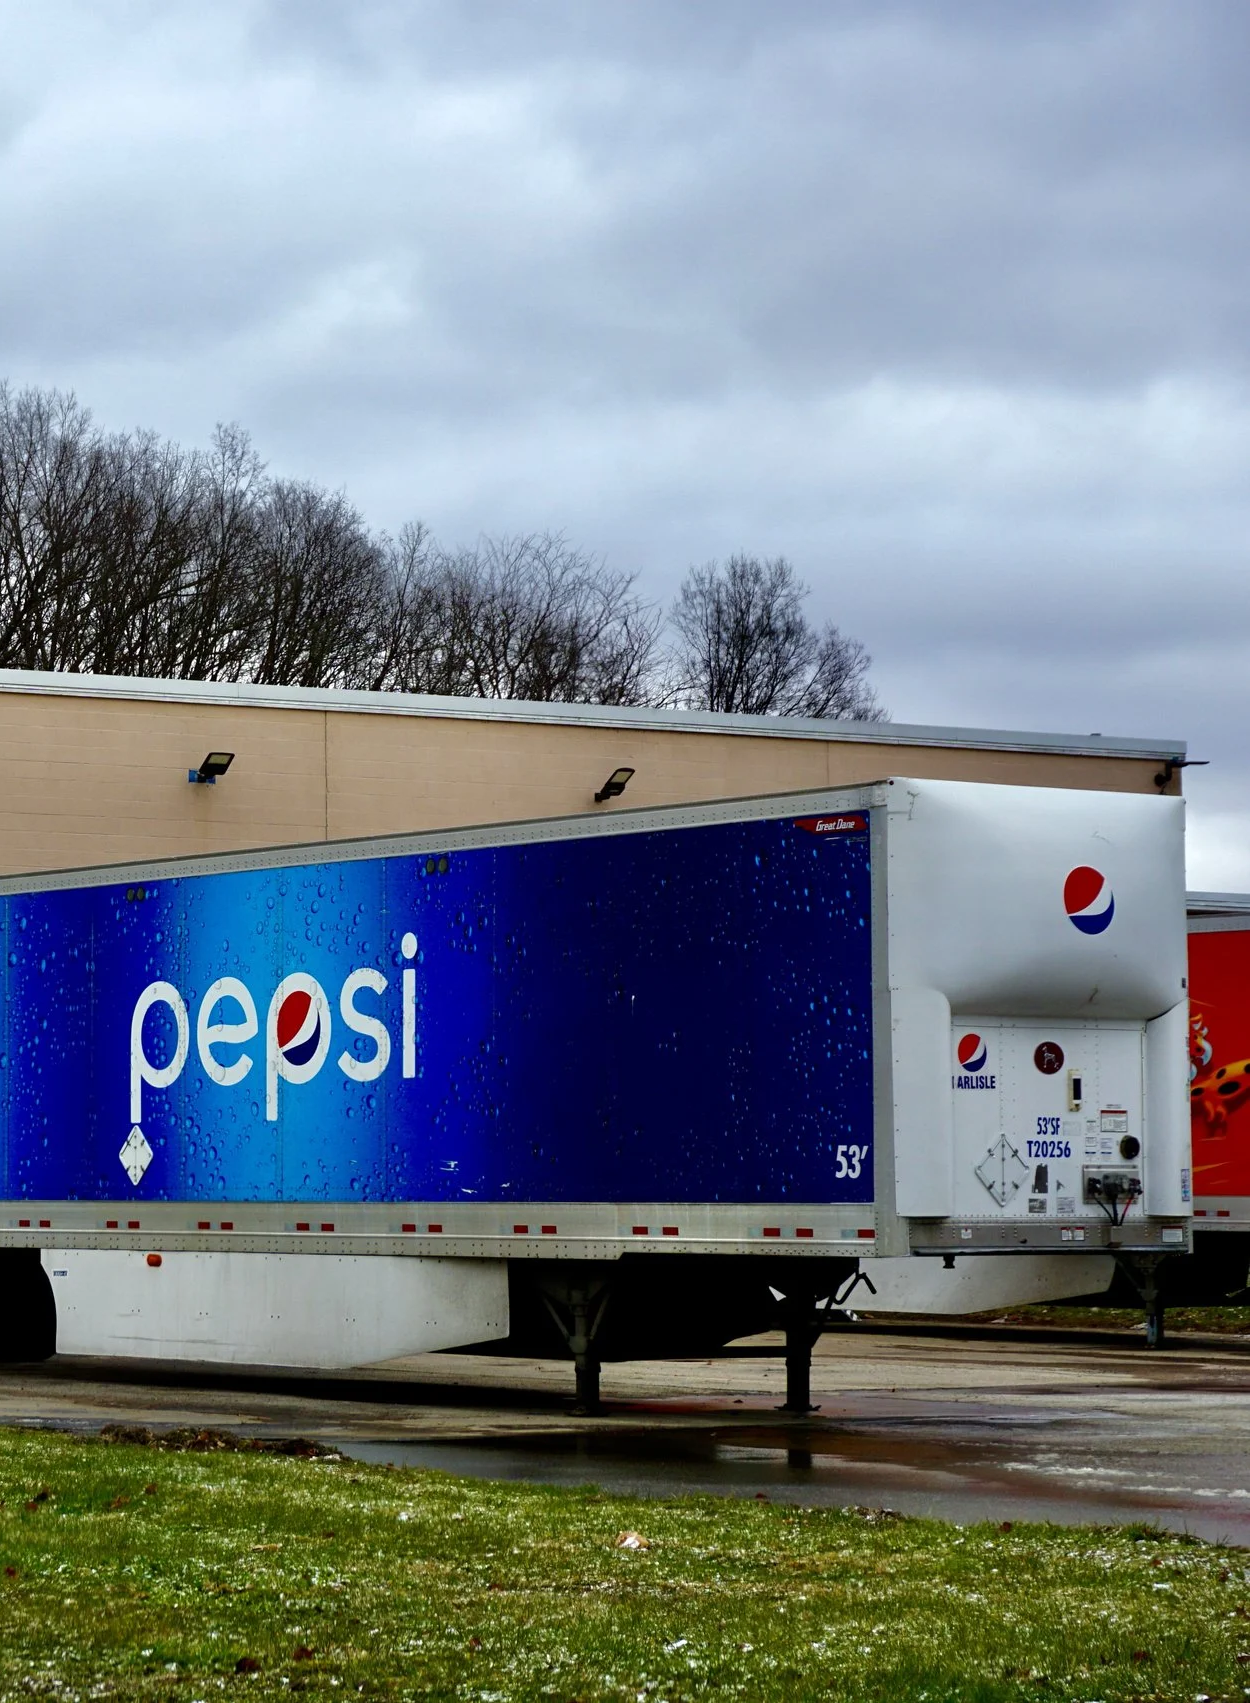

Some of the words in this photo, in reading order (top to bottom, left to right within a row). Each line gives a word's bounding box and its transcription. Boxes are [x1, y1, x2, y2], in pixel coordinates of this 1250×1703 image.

[815, 820, 836, 831] Great
[836, 818, 855, 829] Dane
[130, 932, 418, 1124] pepsi
[951, 1075, 996, 1089] ARLISLE
[1026, 1140, 1071, 1158] T20256
[835, 1144, 869, 1179] 53'
